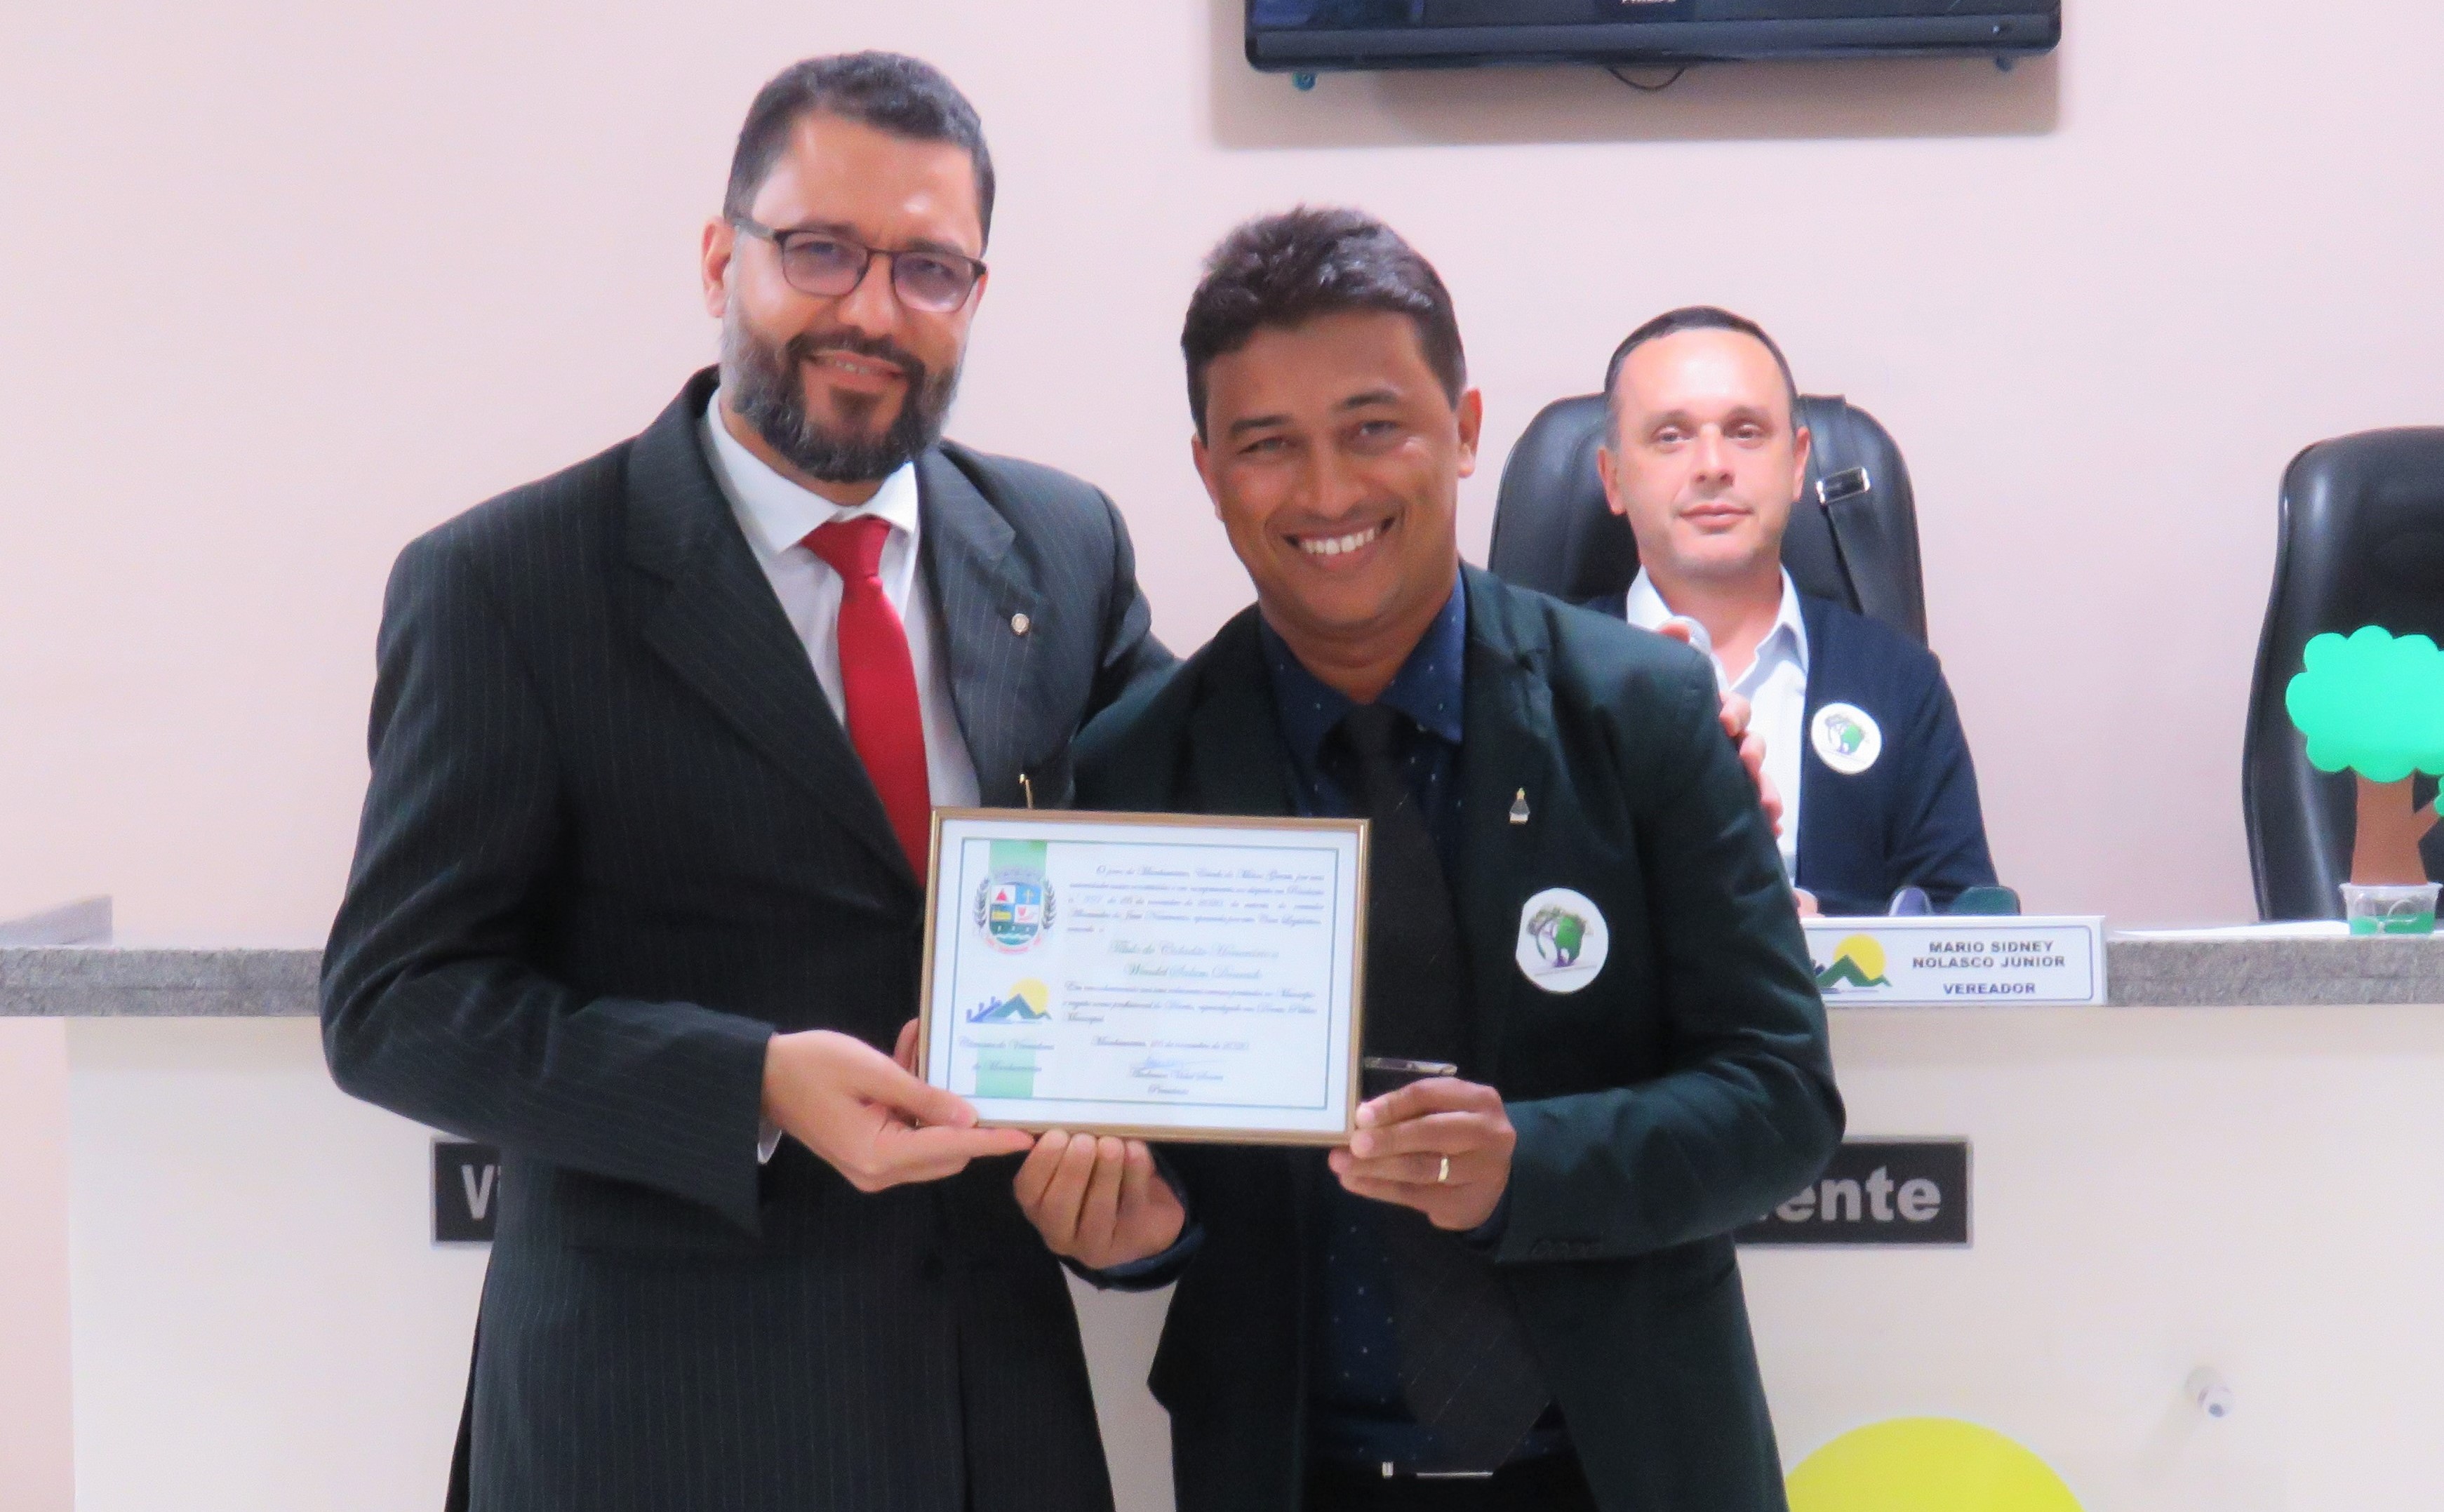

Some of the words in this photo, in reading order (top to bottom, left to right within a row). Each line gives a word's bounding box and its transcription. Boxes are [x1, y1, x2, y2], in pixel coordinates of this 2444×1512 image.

[1929, 941, 1985, 953] MARIO
[1991, 940, 2054, 953] SIDNEY
[1913, 956, 1994, 968] NOLASCO
[2001, 955, 2066, 968] JUNIOR
[1943, 982, 2036, 994] VEREADOR
[1759, 1165, 1942, 1223] ente
